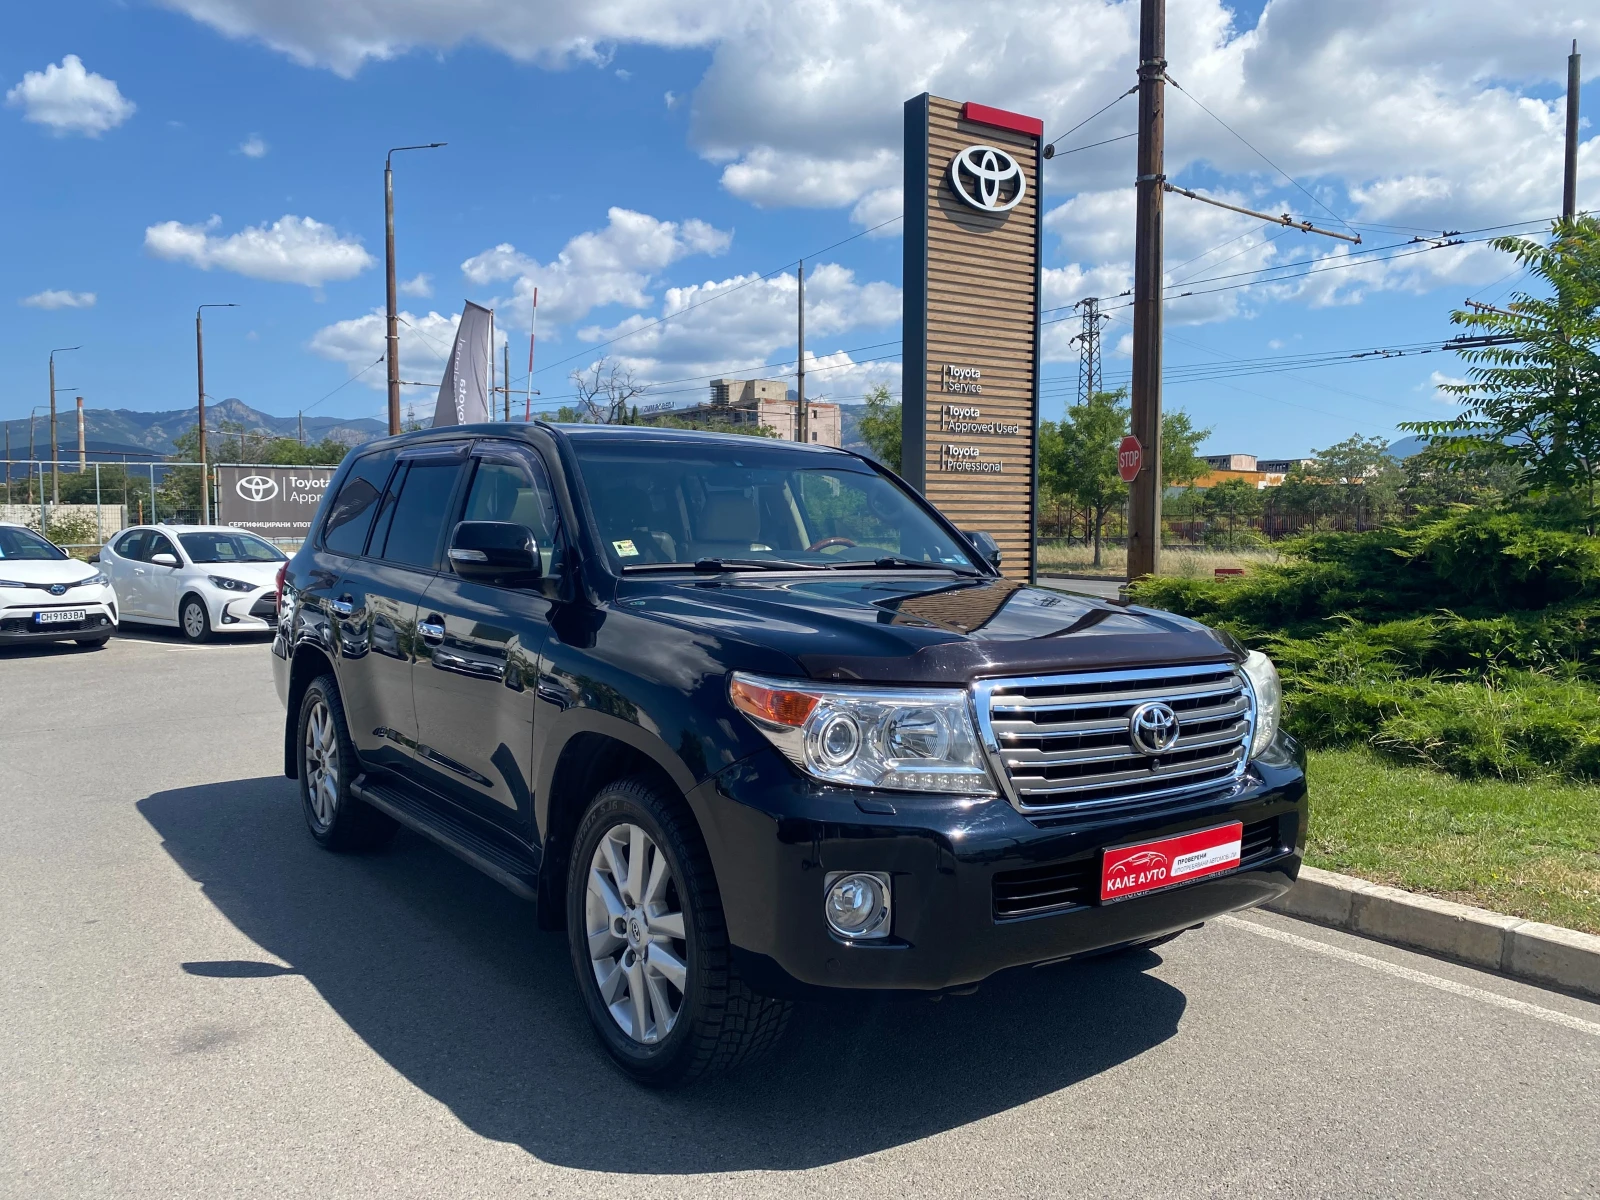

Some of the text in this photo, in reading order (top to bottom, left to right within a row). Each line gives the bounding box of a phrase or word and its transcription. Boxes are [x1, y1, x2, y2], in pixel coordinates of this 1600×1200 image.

[948, 365, 981, 379] Toyota
[948, 380, 983, 393] Service
[948, 405, 980, 418] Toyota
[948, 420, 1019, 434] Approved Used
[947, 445, 980, 458] Toyota
[1120, 450, 1140, 468] STOP
[947, 460, 1003, 472] Professional
[289, 491, 324, 505] Appr
[228, 521, 291, 529] СЕРТИФИЦИРАНИ
[1106, 874, 1136, 892] КАЛЕ
[1138, 867, 1167, 884] АУТО
